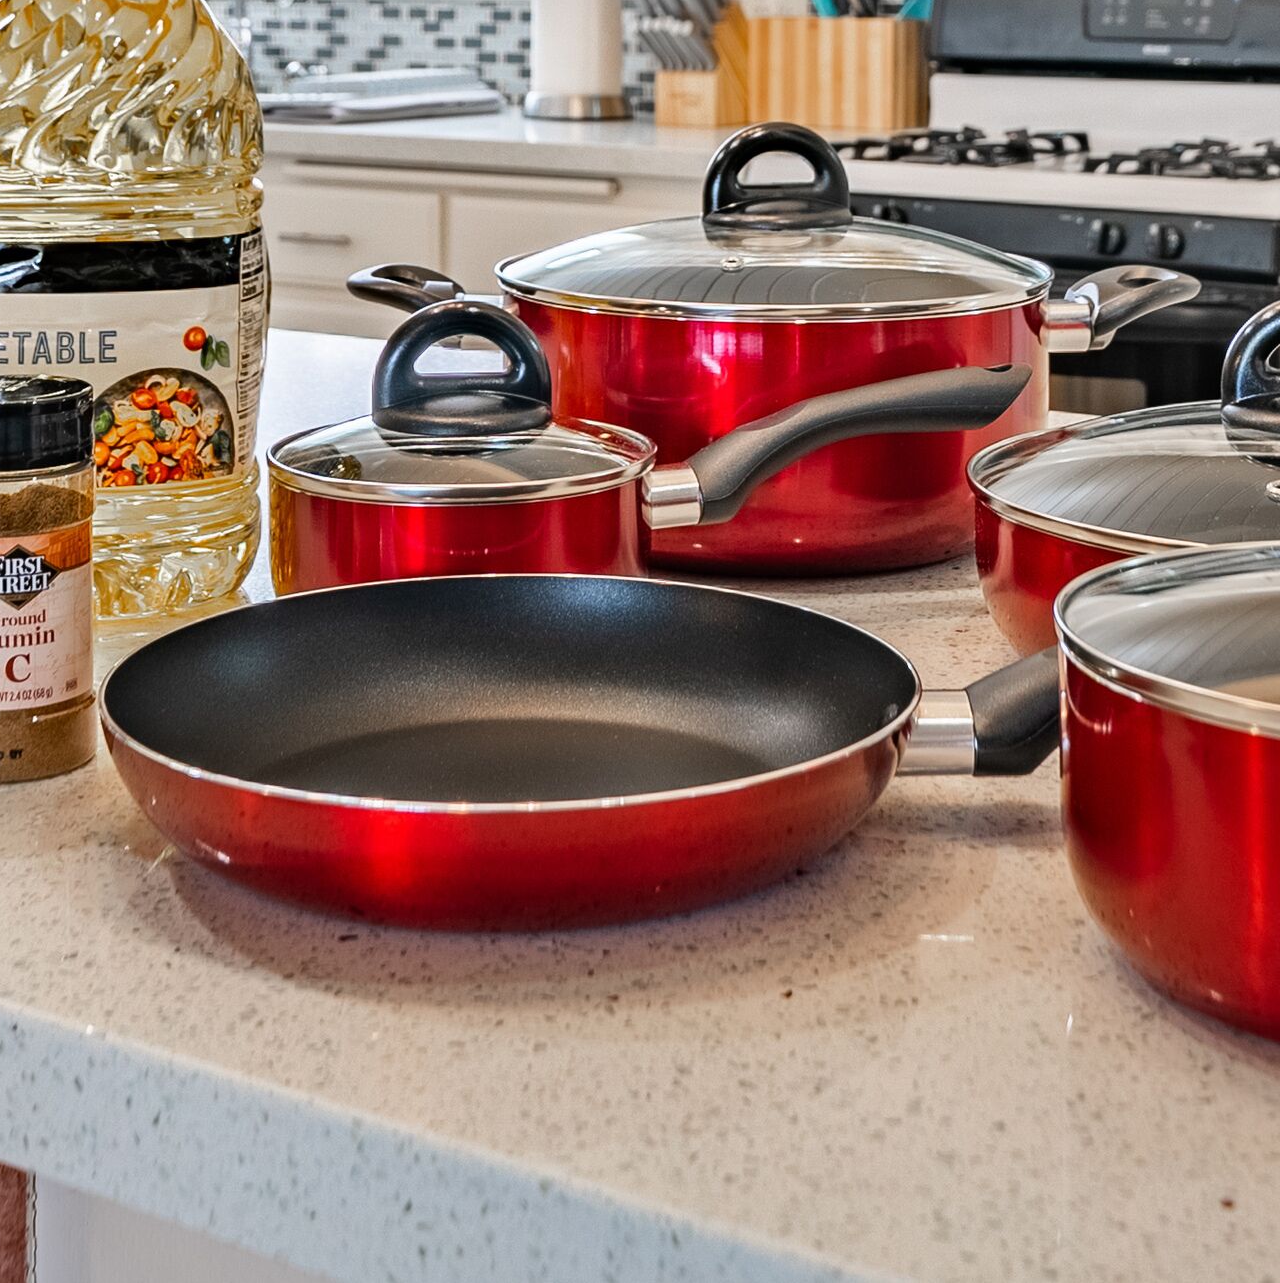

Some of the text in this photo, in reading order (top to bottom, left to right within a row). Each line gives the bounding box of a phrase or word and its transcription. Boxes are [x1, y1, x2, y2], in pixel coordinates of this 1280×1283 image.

[5, 654, 32, 683] C
[10, 690, 20, 701] 2.4
[22, 690, 32, 701] OZ
